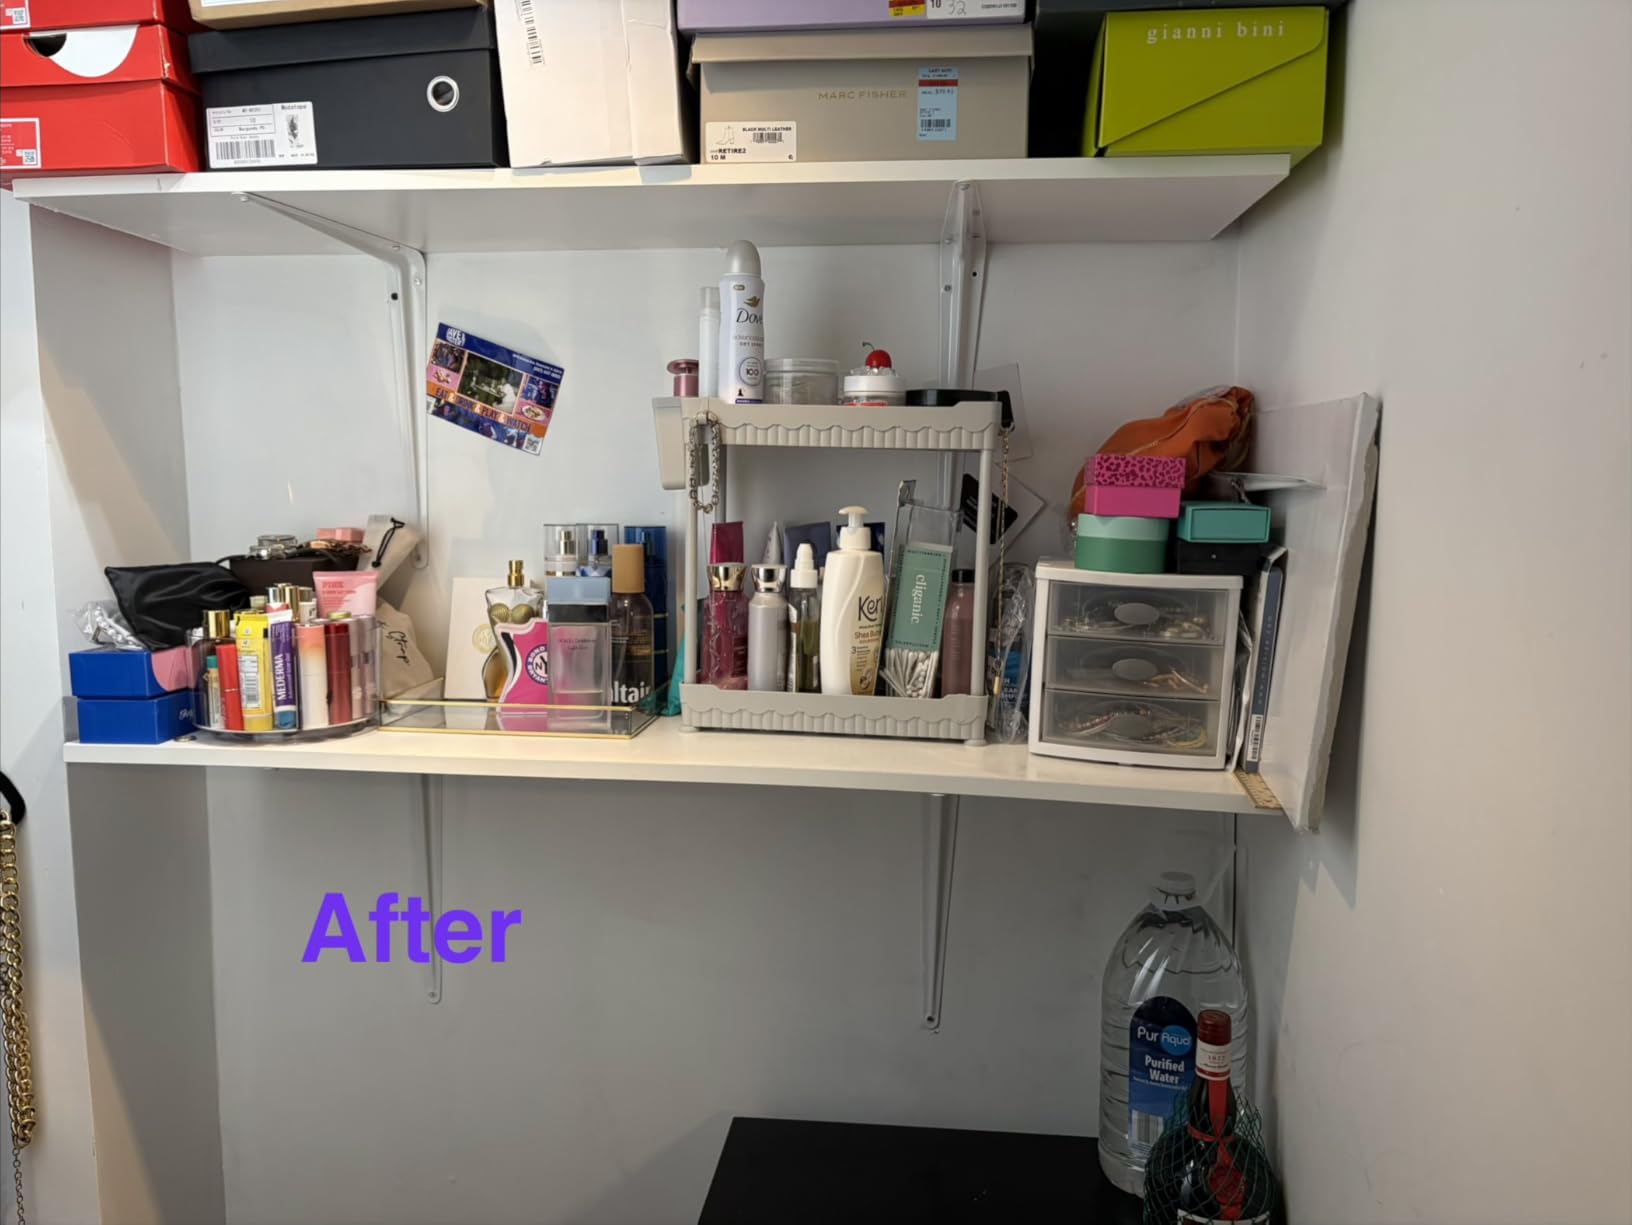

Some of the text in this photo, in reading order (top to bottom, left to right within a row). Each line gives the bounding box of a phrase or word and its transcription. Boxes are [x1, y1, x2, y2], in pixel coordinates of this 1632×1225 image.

[1147, 21, 1284, 44] gianni bini
[818, 90, 906, 100] MARC FISHER
[911, 574, 927, 624] cliganic
[274, 653, 287, 700] MEDERMA
[1137, 1026, 1159, 1041] Pur
[1145, 1054, 1185, 1073] Purified
[1149, 1069, 1180, 1084] Water
